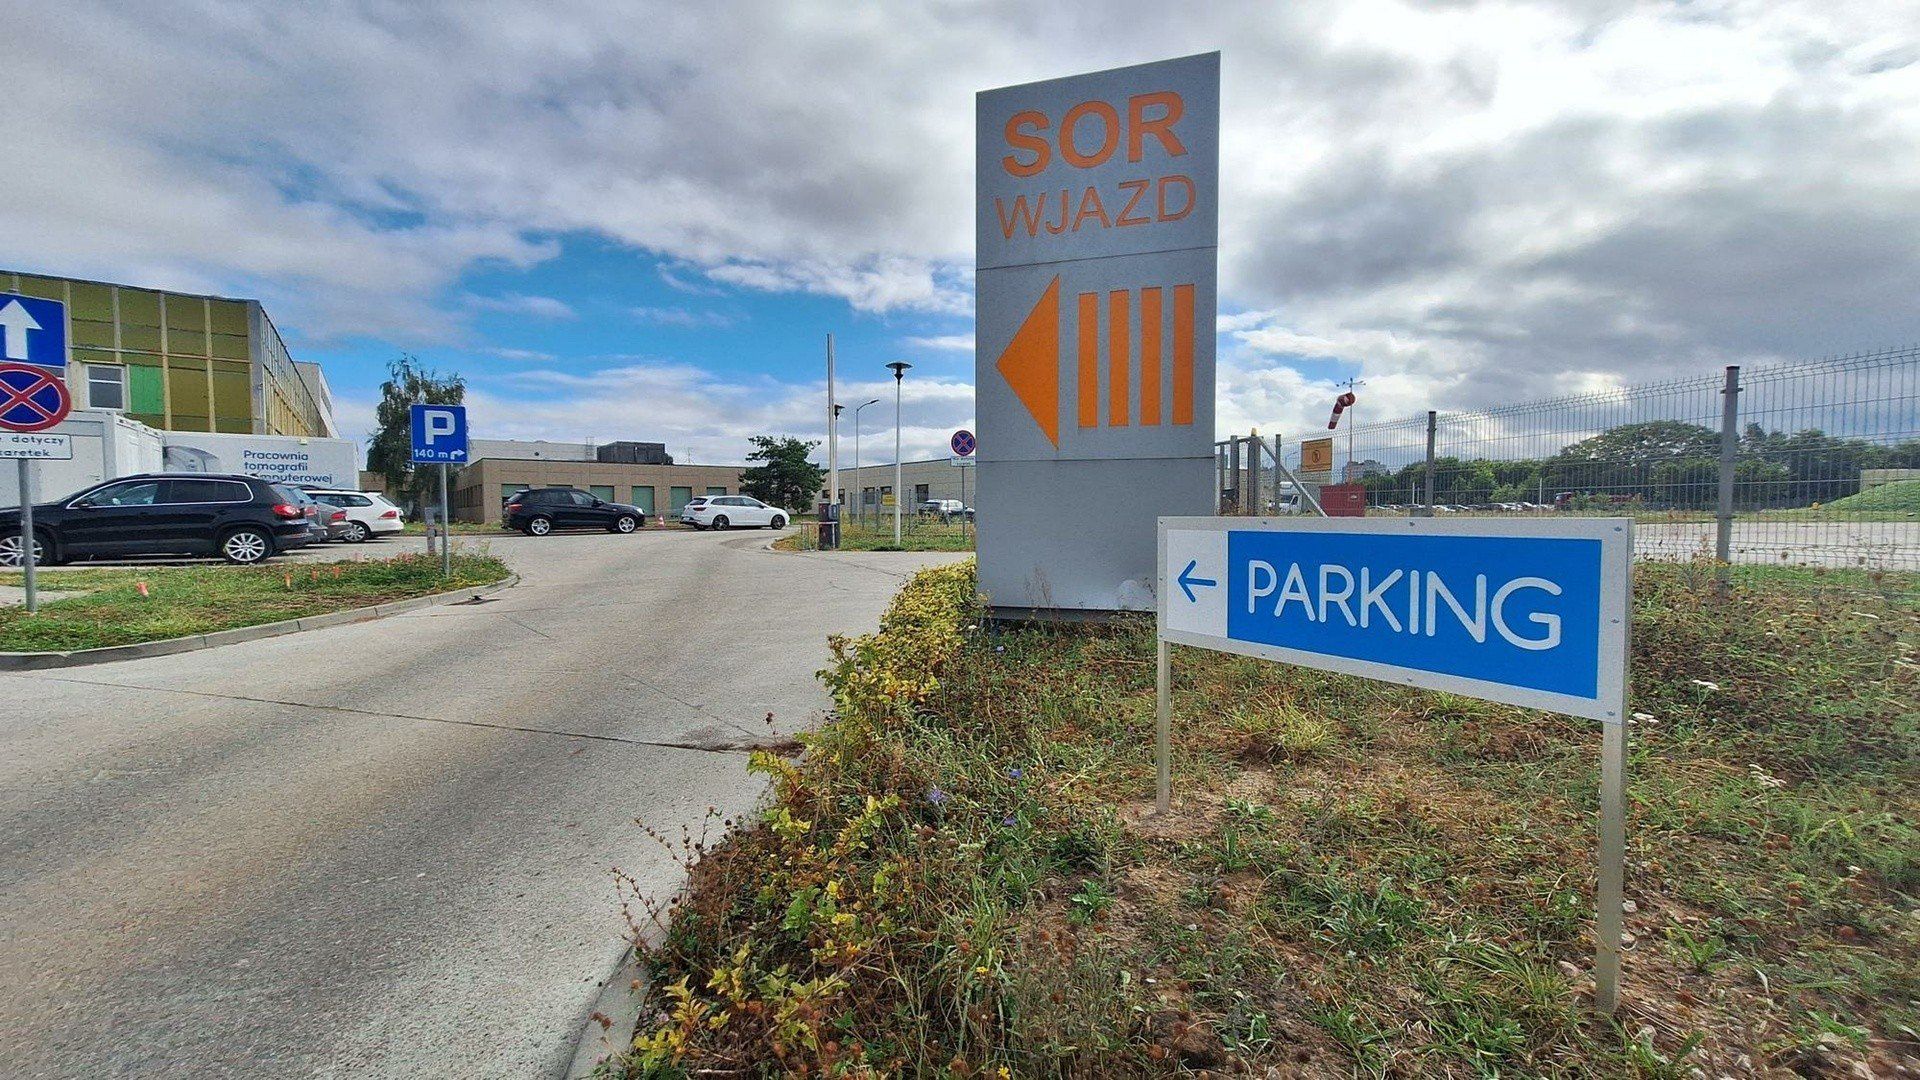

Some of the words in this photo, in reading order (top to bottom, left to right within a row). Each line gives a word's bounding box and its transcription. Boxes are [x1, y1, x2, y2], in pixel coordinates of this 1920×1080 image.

[1002, 91, 1189, 178] SOR
[994, 174, 1197, 241] WJAZD
[424, 410, 456, 445] P
[11, 436, 64, 446] dotyczy
[243, 450, 309, 461] Pracownia
[414, 449, 435, 458] 140
[437, 451, 448, 459] m
[244, 462, 308, 473] tomografii
[244, 472, 332, 484] mputerowej
[1248, 559, 1563, 651] PARKING
